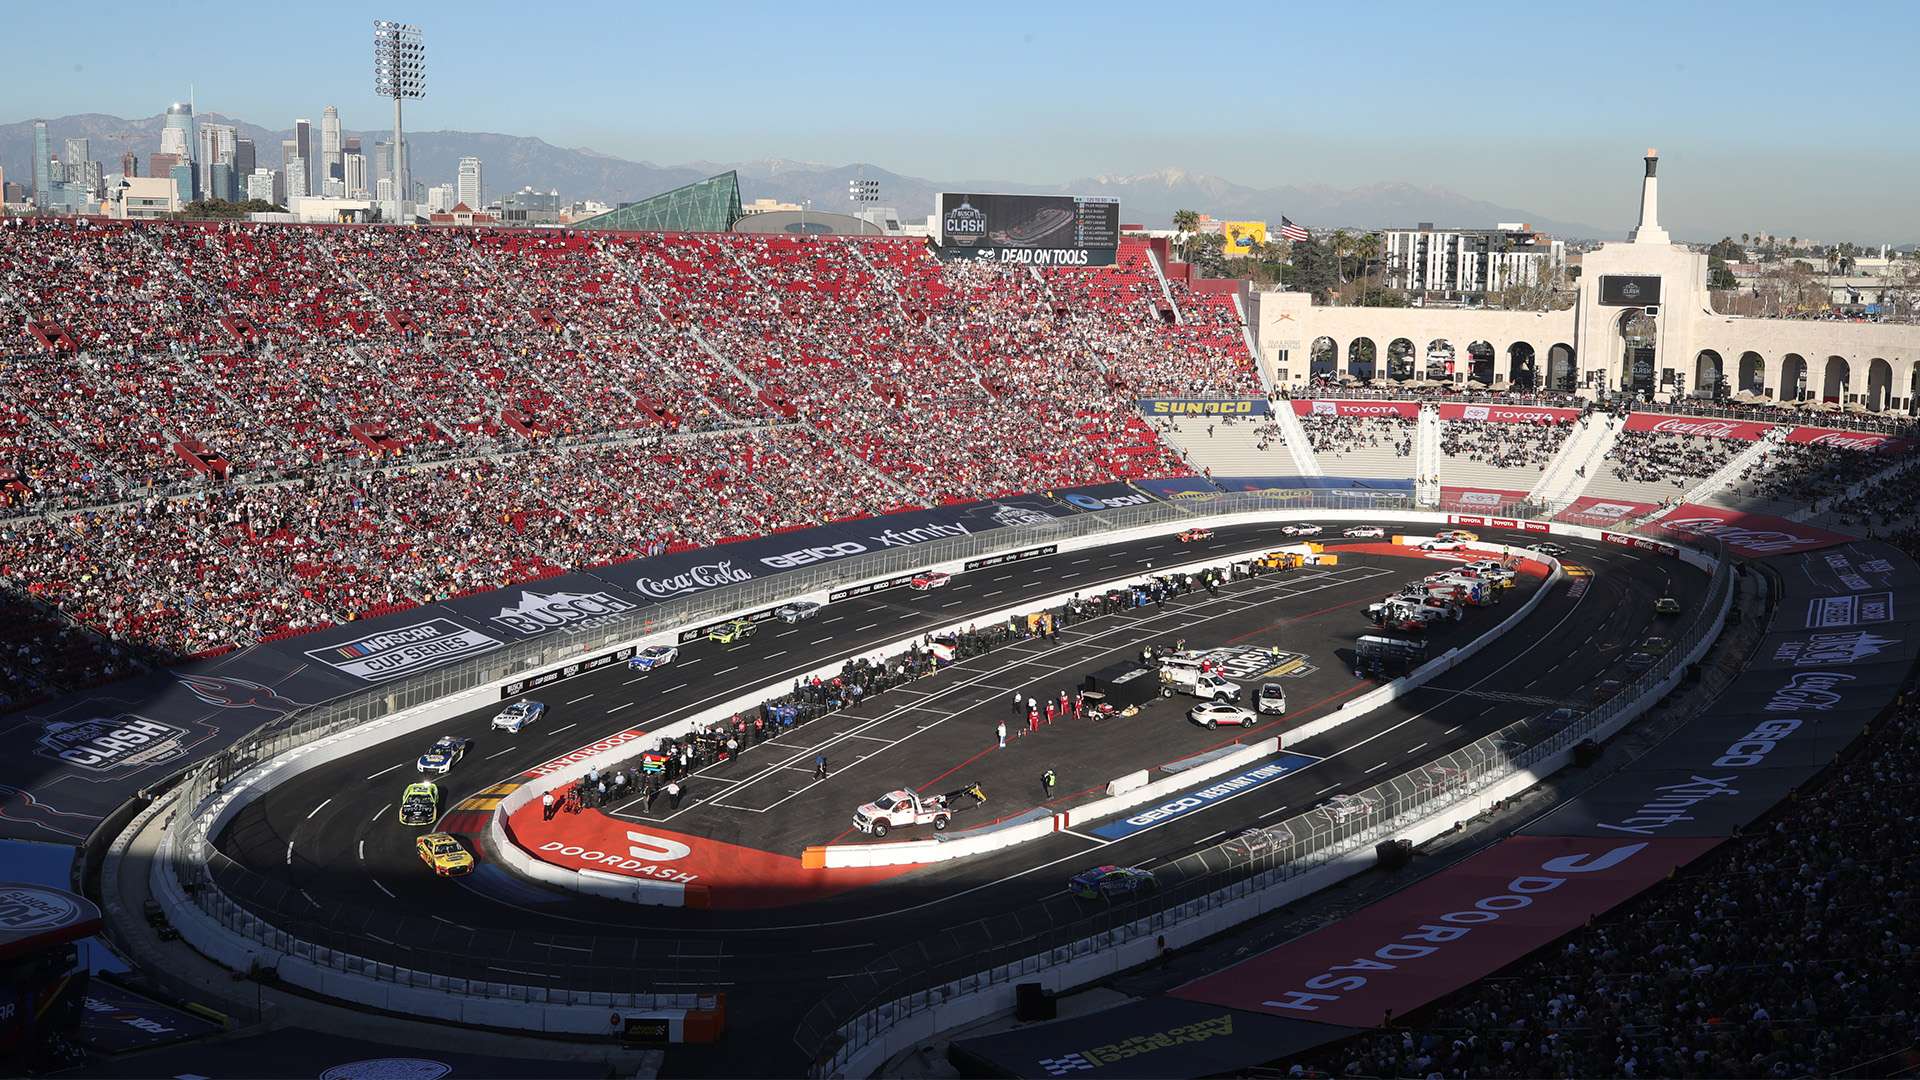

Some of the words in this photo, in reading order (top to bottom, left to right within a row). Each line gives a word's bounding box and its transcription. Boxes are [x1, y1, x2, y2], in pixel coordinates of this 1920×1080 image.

[946, 219, 985, 232] CLASH
[1001, 248, 1033, 263] DEAD
[1034, 249, 1052, 264] ON
[1053, 249, 1088, 265] TOOLS
[1153, 401, 1252, 413] SUNOCO
[1340, 405, 1399, 414] TOYOTA
[1494, 411, 1554, 421] TOYOTA
[1653, 418, 1741, 437] Coca-Cola
[1459, 517, 1481, 525] TOYOTA
[1493, 520, 1515, 528] TOYOTA
[869, 522, 973, 547] xfinity
[760, 541, 868, 569] GEICO
[636, 560, 751, 598] Coca-Cola
[831, 592, 847, 600] GEICO
[873, 581, 889, 590] GEICO
[491, 592, 637, 635] BUSCH
[362, 625, 442, 653] NASCAR
[365, 654, 402, 671] CUP
[404, 637, 469, 660] SERIES
[617, 649, 631, 659] BUSCH
[563, 664, 579, 675] BUSCH
[507, 682, 523, 693] BUSCH
[59, 720, 171, 765] CLASH
[1711, 719, 1803, 768] GEICO
[1126, 798, 1203, 826] GEICO
[1195, 775, 1257, 799] RESTART
[1247, 764, 1288, 781] ZONE
[1596, 774, 1740, 834] xfinity
[539, 841, 699, 883] DOORDASH
[1261, 876, 1568, 1012] DOORDASH
